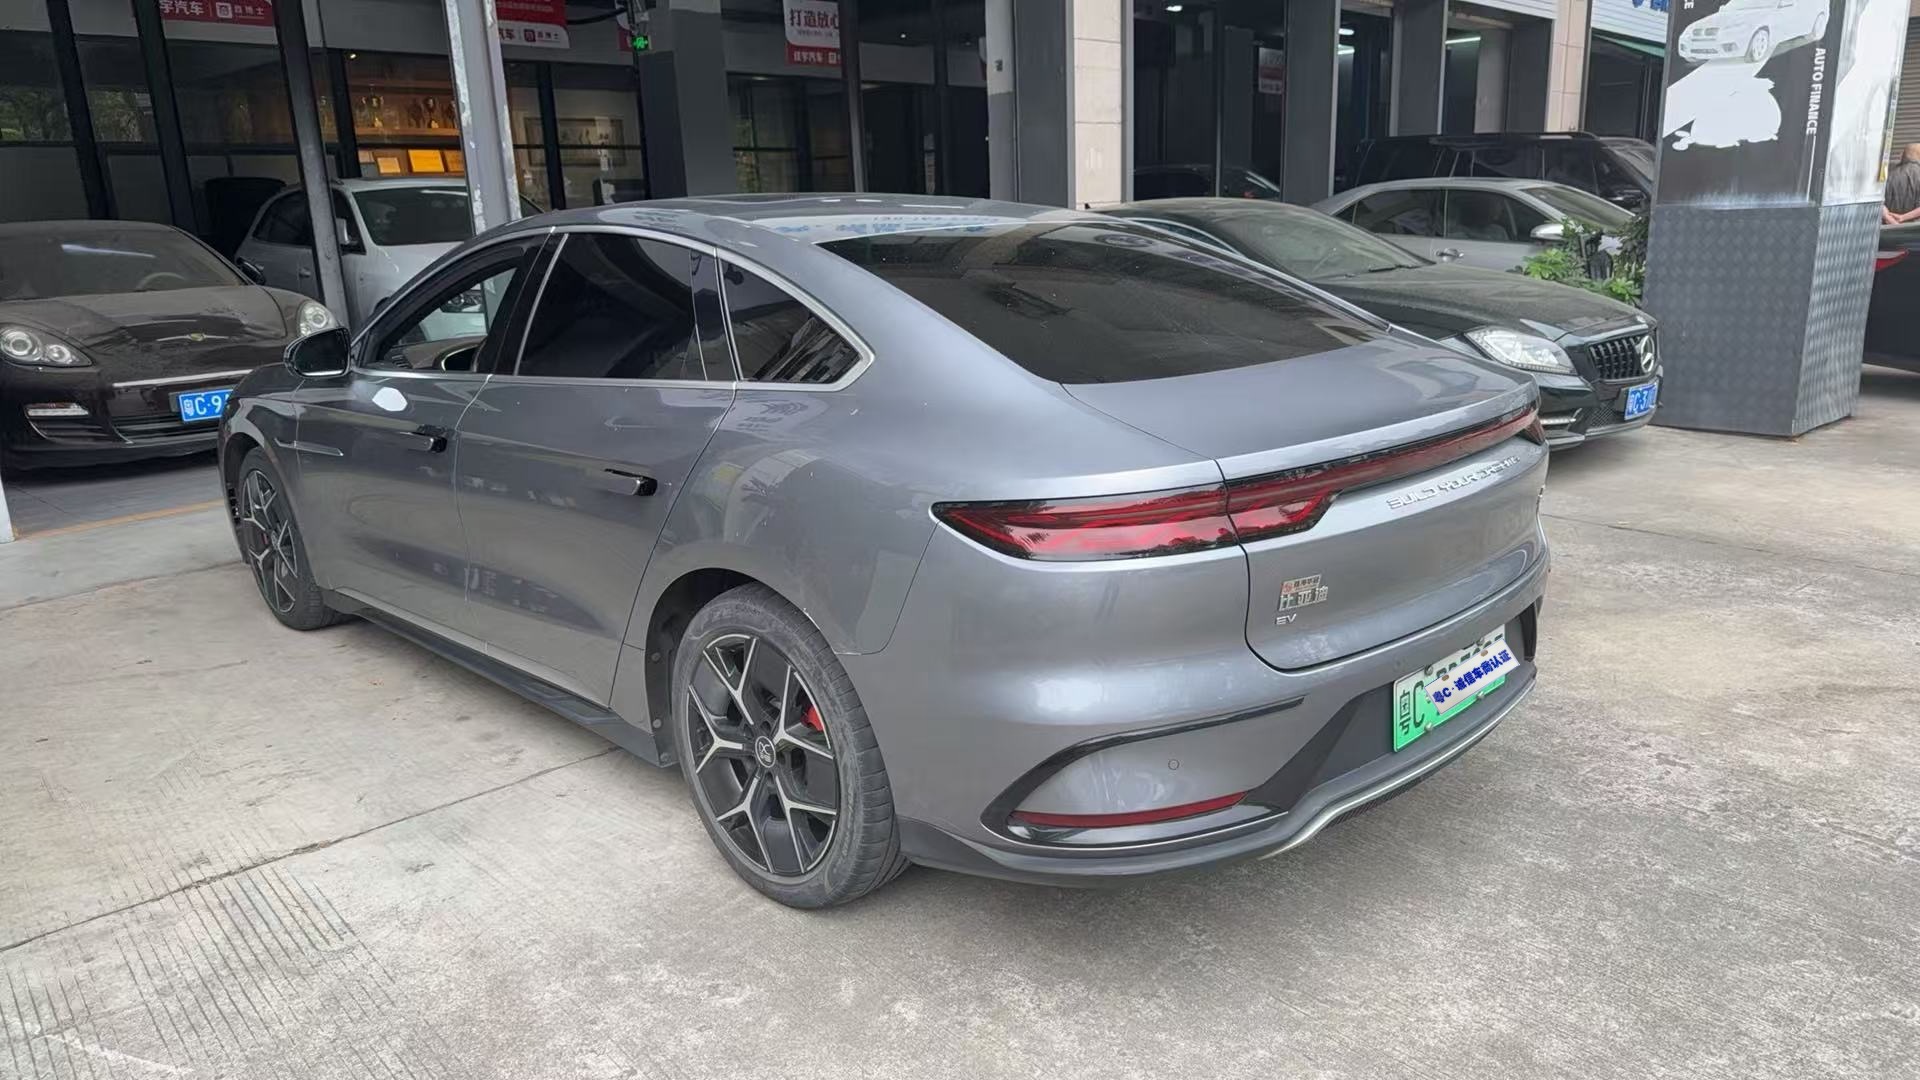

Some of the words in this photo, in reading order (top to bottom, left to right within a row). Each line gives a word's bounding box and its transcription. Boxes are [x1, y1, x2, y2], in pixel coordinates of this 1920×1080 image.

[1812, 48, 1826, 81] AUTO
[1806, 83, 1822, 135] FINANCE
[1279, 585, 1329, 611] 比亚迪
[1276, 613, 1297, 625] EV
